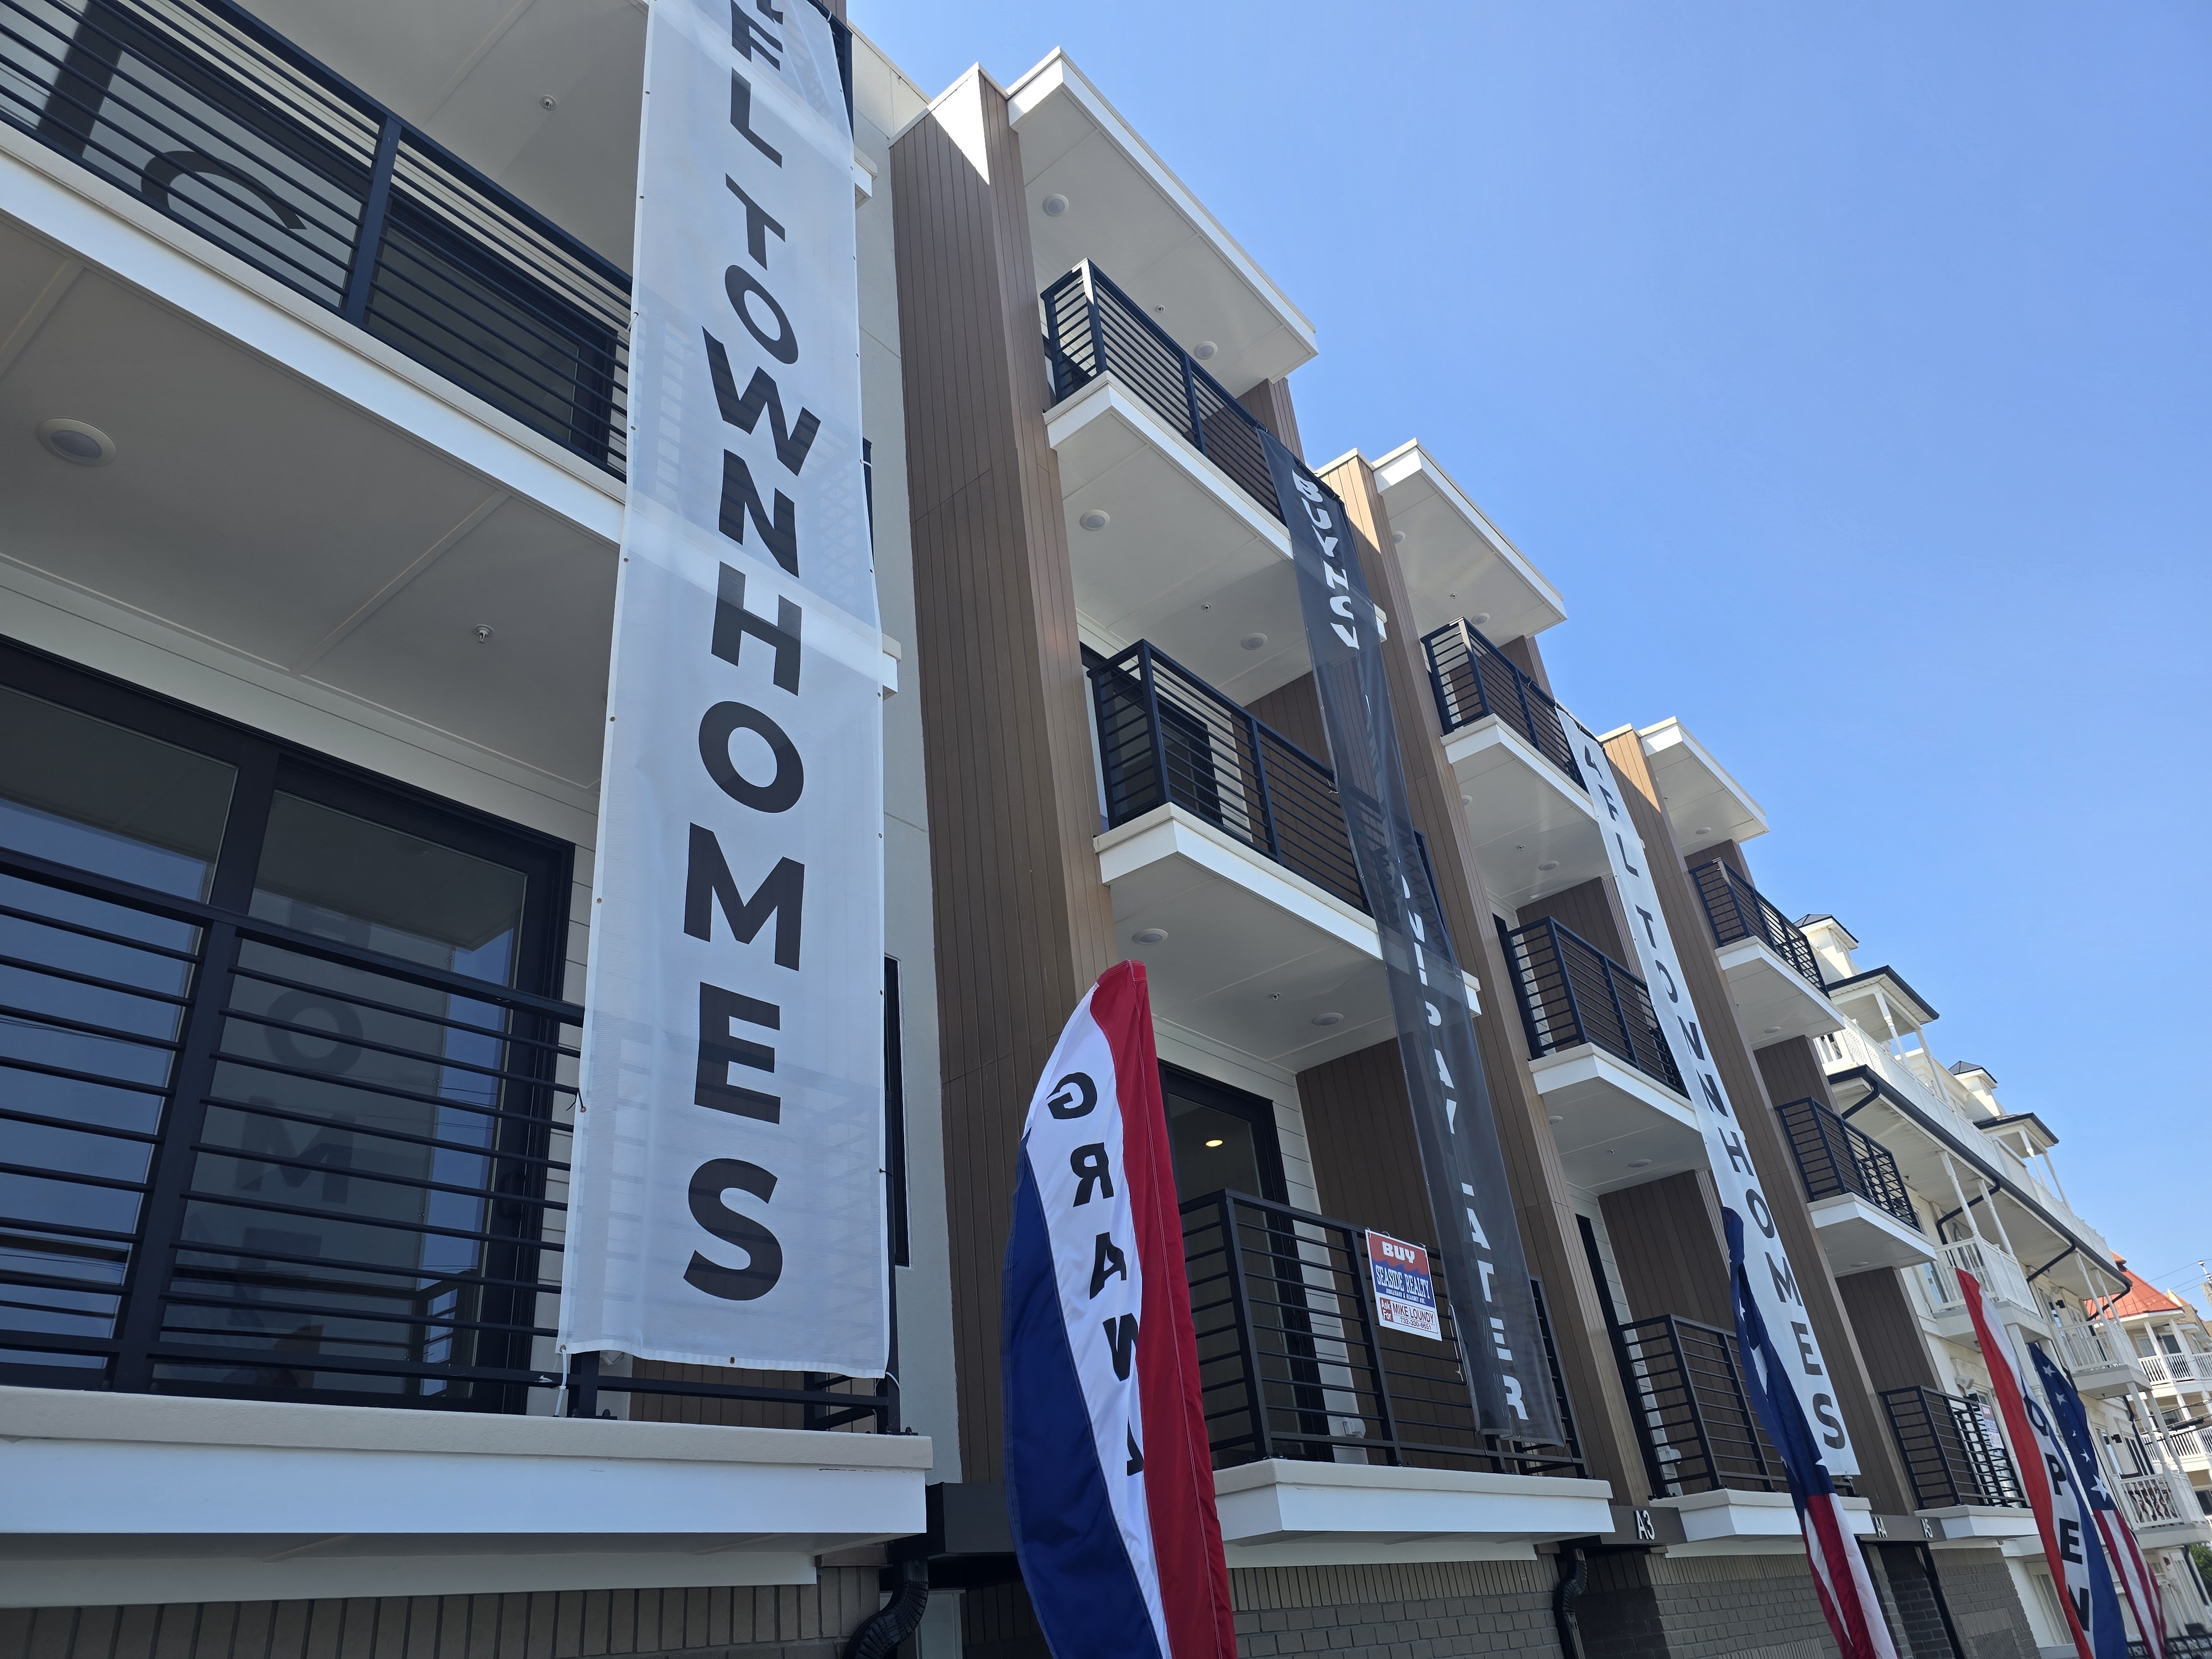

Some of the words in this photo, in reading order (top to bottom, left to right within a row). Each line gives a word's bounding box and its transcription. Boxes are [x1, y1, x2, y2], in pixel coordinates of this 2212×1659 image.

[1292, 469, 1339, 557] BUY
[684, 173, 821, 1301] TOWNHOMES
[1382, 1241, 1415, 1264] BUY
[1375, 1264, 1405, 1292] SEASIDE
[1404, 1273, 1431, 1299] REALTY
[1381, 1299, 1391, 1311] Ask
[1383, 1309, 1392, 1321] For
[1392, 1303, 1409, 1317] MIKE
[1409, 1307, 1433, 1323] LOUNDY
[2023, 1394, 2090, 1632] OPEN
[1635, 1510, 1655, 1540] A3
[1874, 1516, 1888, 1538] A4
[1921, 1518, 1933, 1538] A5
